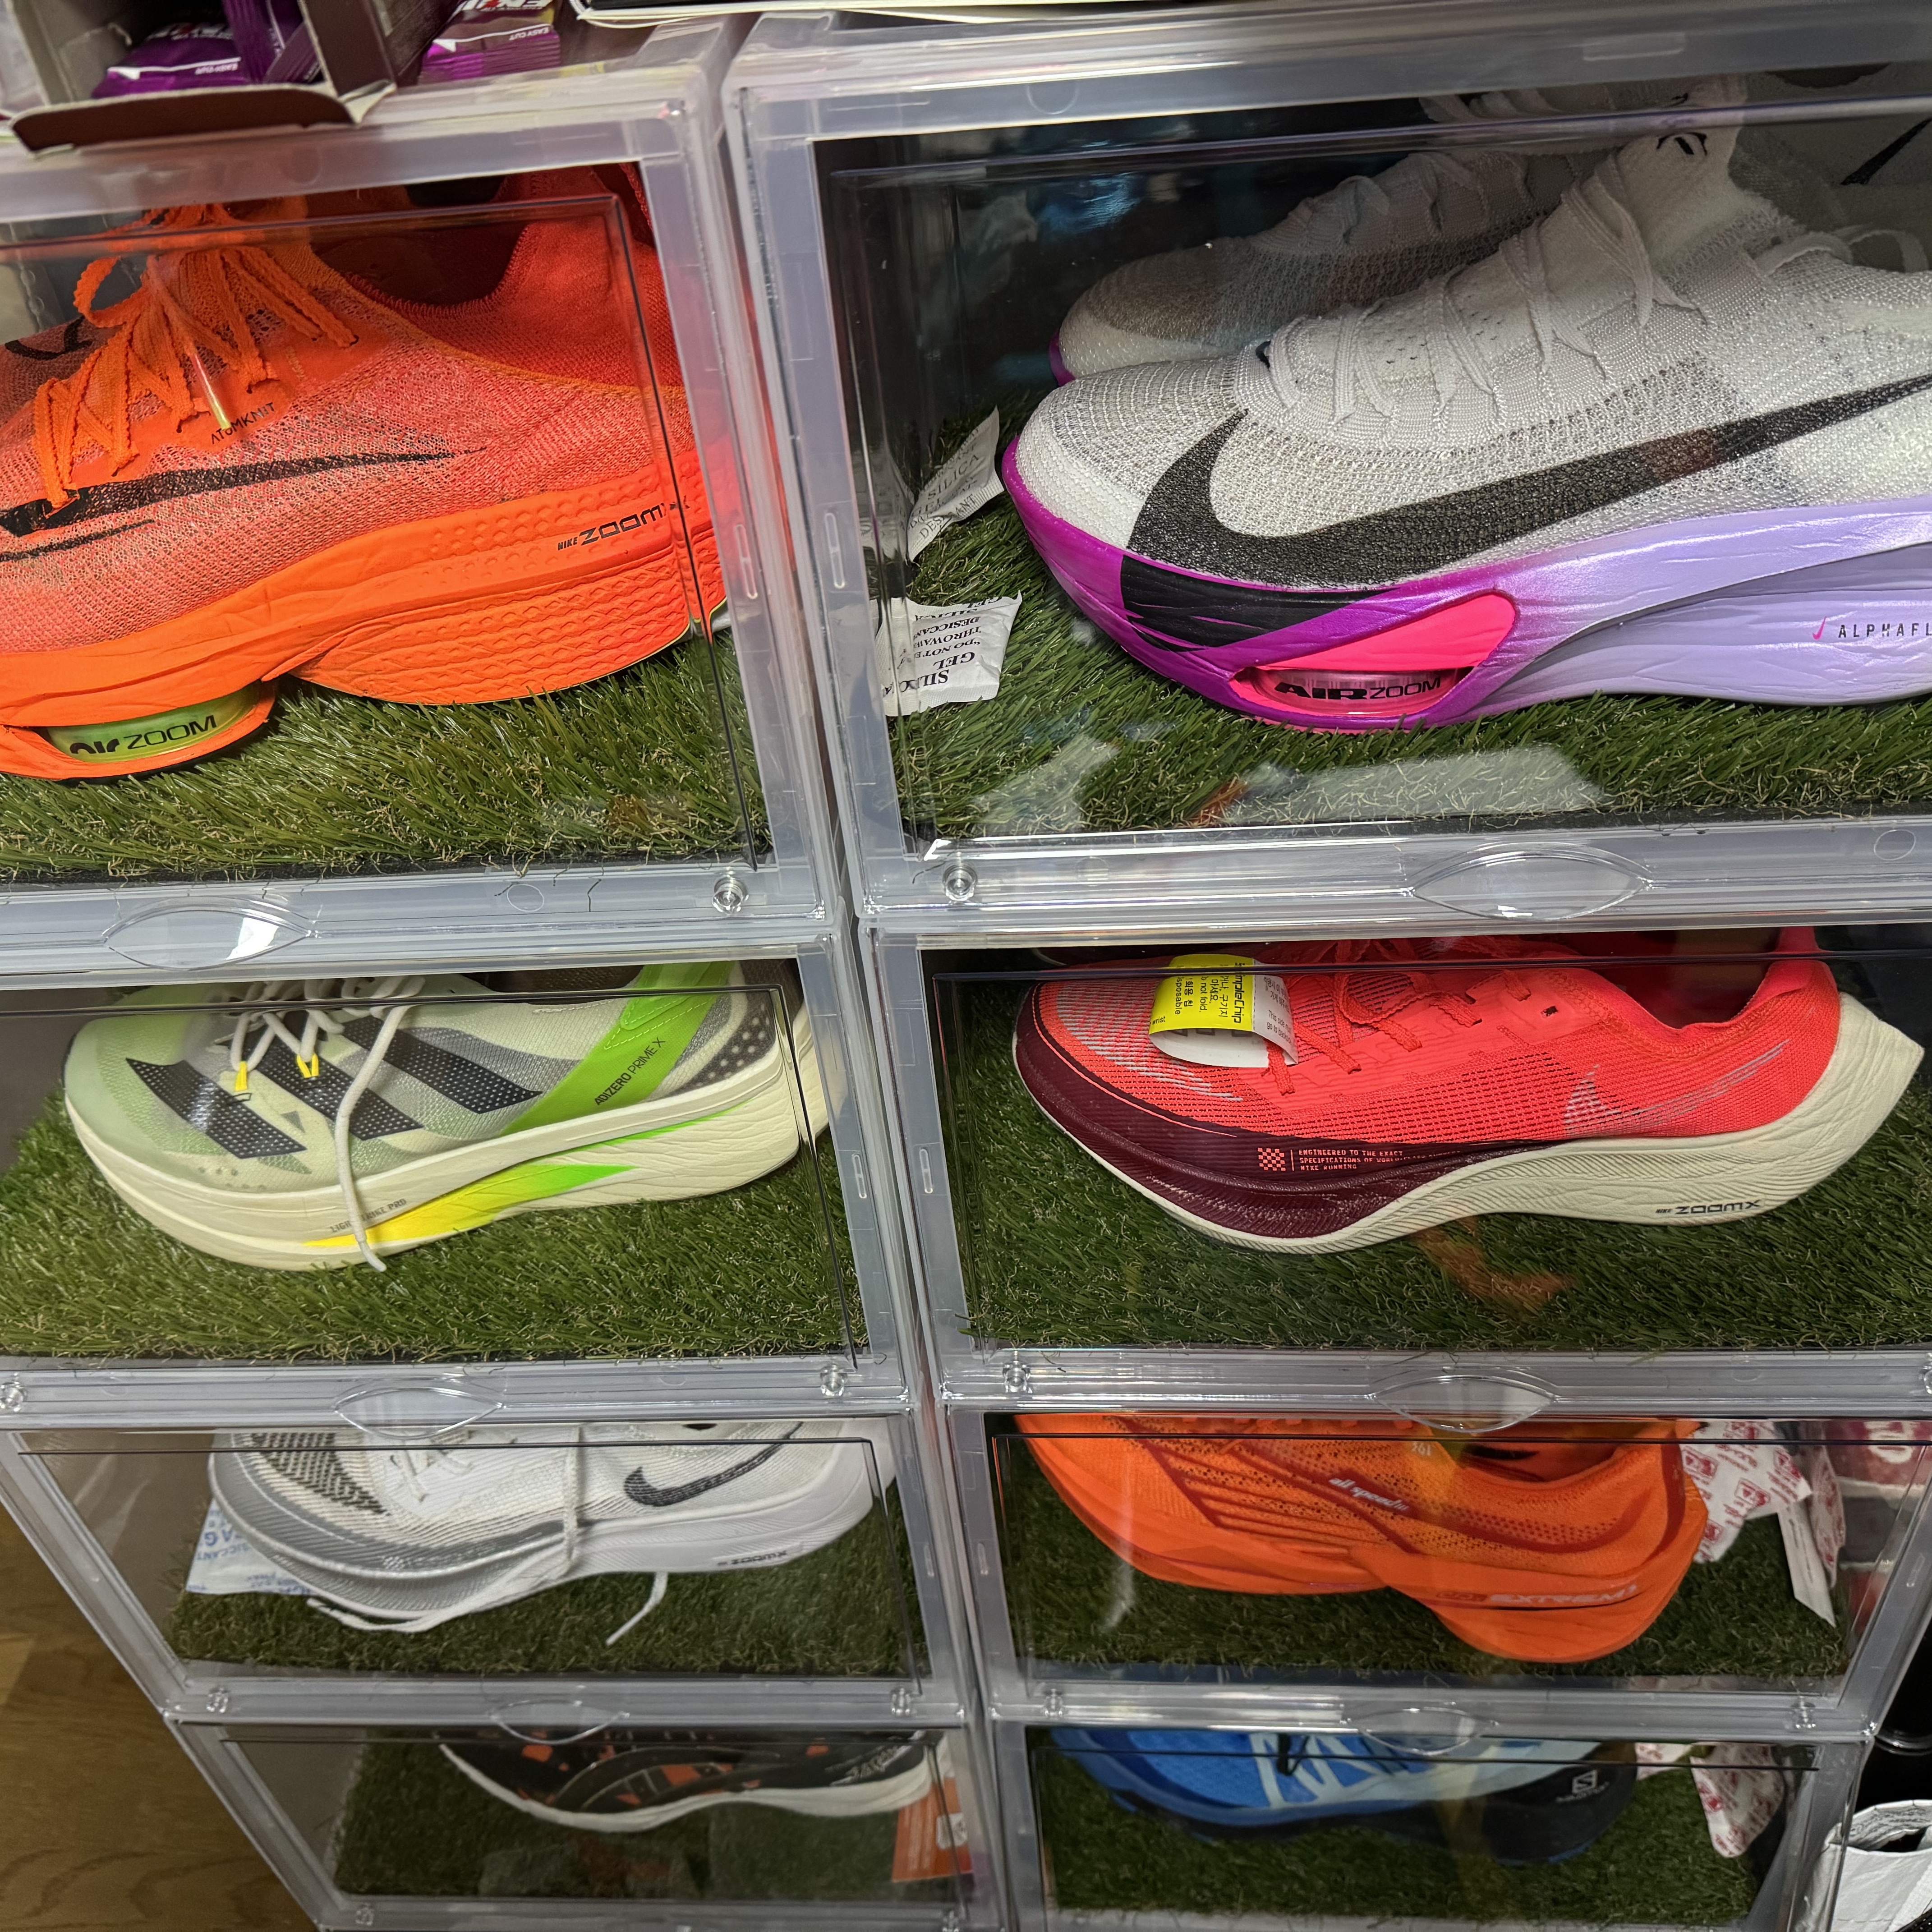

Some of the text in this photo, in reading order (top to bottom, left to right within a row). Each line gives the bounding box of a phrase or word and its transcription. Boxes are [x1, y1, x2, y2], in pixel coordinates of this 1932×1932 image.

[558, 537, 578, 551] NIKE
[933, 652, 975, 671] GEL
[1274, 676, 1441, 699] AIR ZOOM
[124, 715, 217, 750] ZOOM
[1200, 982, 1208, 994] not
[1209, 979, 1219, 1004] 마세요.
[1199, 997, 1208, 1012] fold.
[1218, 994, 1228, 1017] 구기지
[1267, 1022, 1273, 1030] go
[1274, 1024, 1278, 1033] to
[594, 1037, 666, 1106] ADIZERO PRIME X
[387, 1198, 407, 1210] PRO
[1674, 1199, 1761, 1214] ZOOMX
